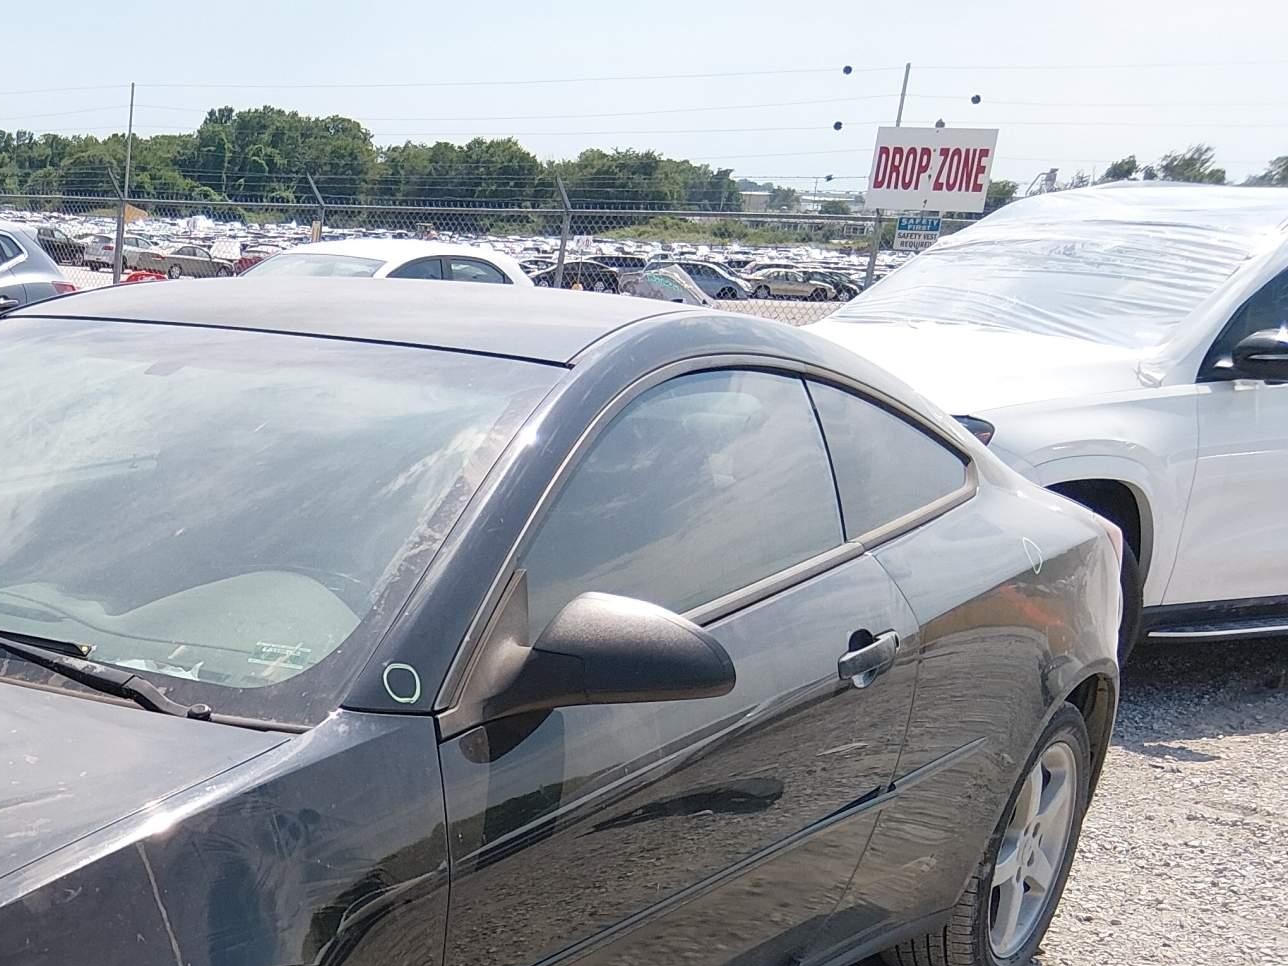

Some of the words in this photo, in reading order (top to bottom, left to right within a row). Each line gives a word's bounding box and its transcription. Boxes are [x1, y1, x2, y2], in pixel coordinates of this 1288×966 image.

[873, 146, 931, 190] DROP
[932, 147, 990, 192] ZONE
[897, 232, 921, 240] SAFETY
[922, 233, 938, 241] VEST
